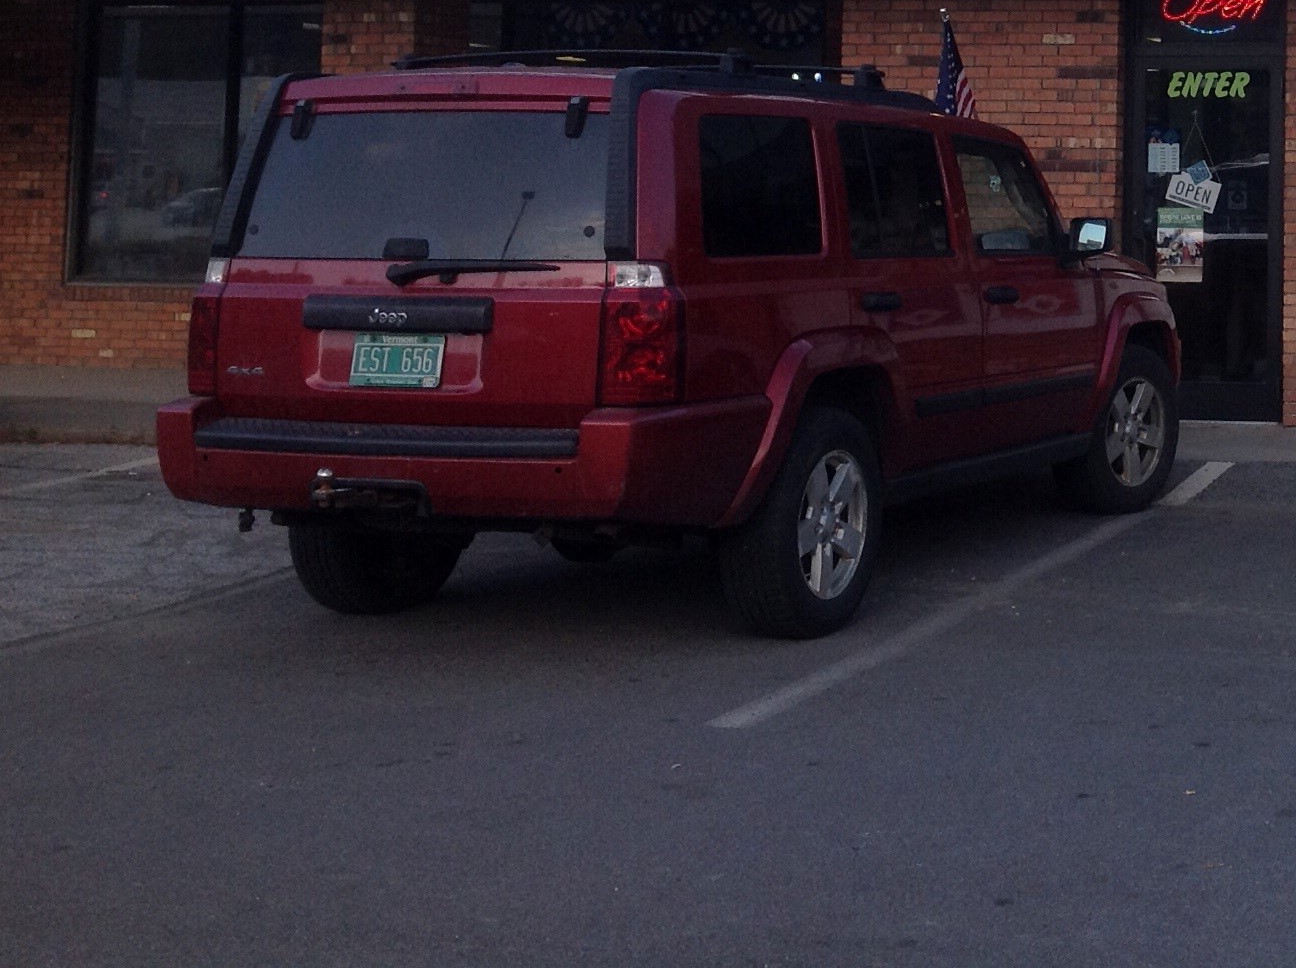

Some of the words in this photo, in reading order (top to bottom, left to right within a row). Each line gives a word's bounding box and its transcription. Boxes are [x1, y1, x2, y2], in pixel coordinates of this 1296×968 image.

[1167, 71, 1250, 98] ENTER
[1175, 180, 1212, 205] OPEN
[368, 308, 408, 327] Jeep
[382, 335, 419, 344] Vermont
[359, 347, 391, 372] EST
[401, 348, 433, 373] 656
